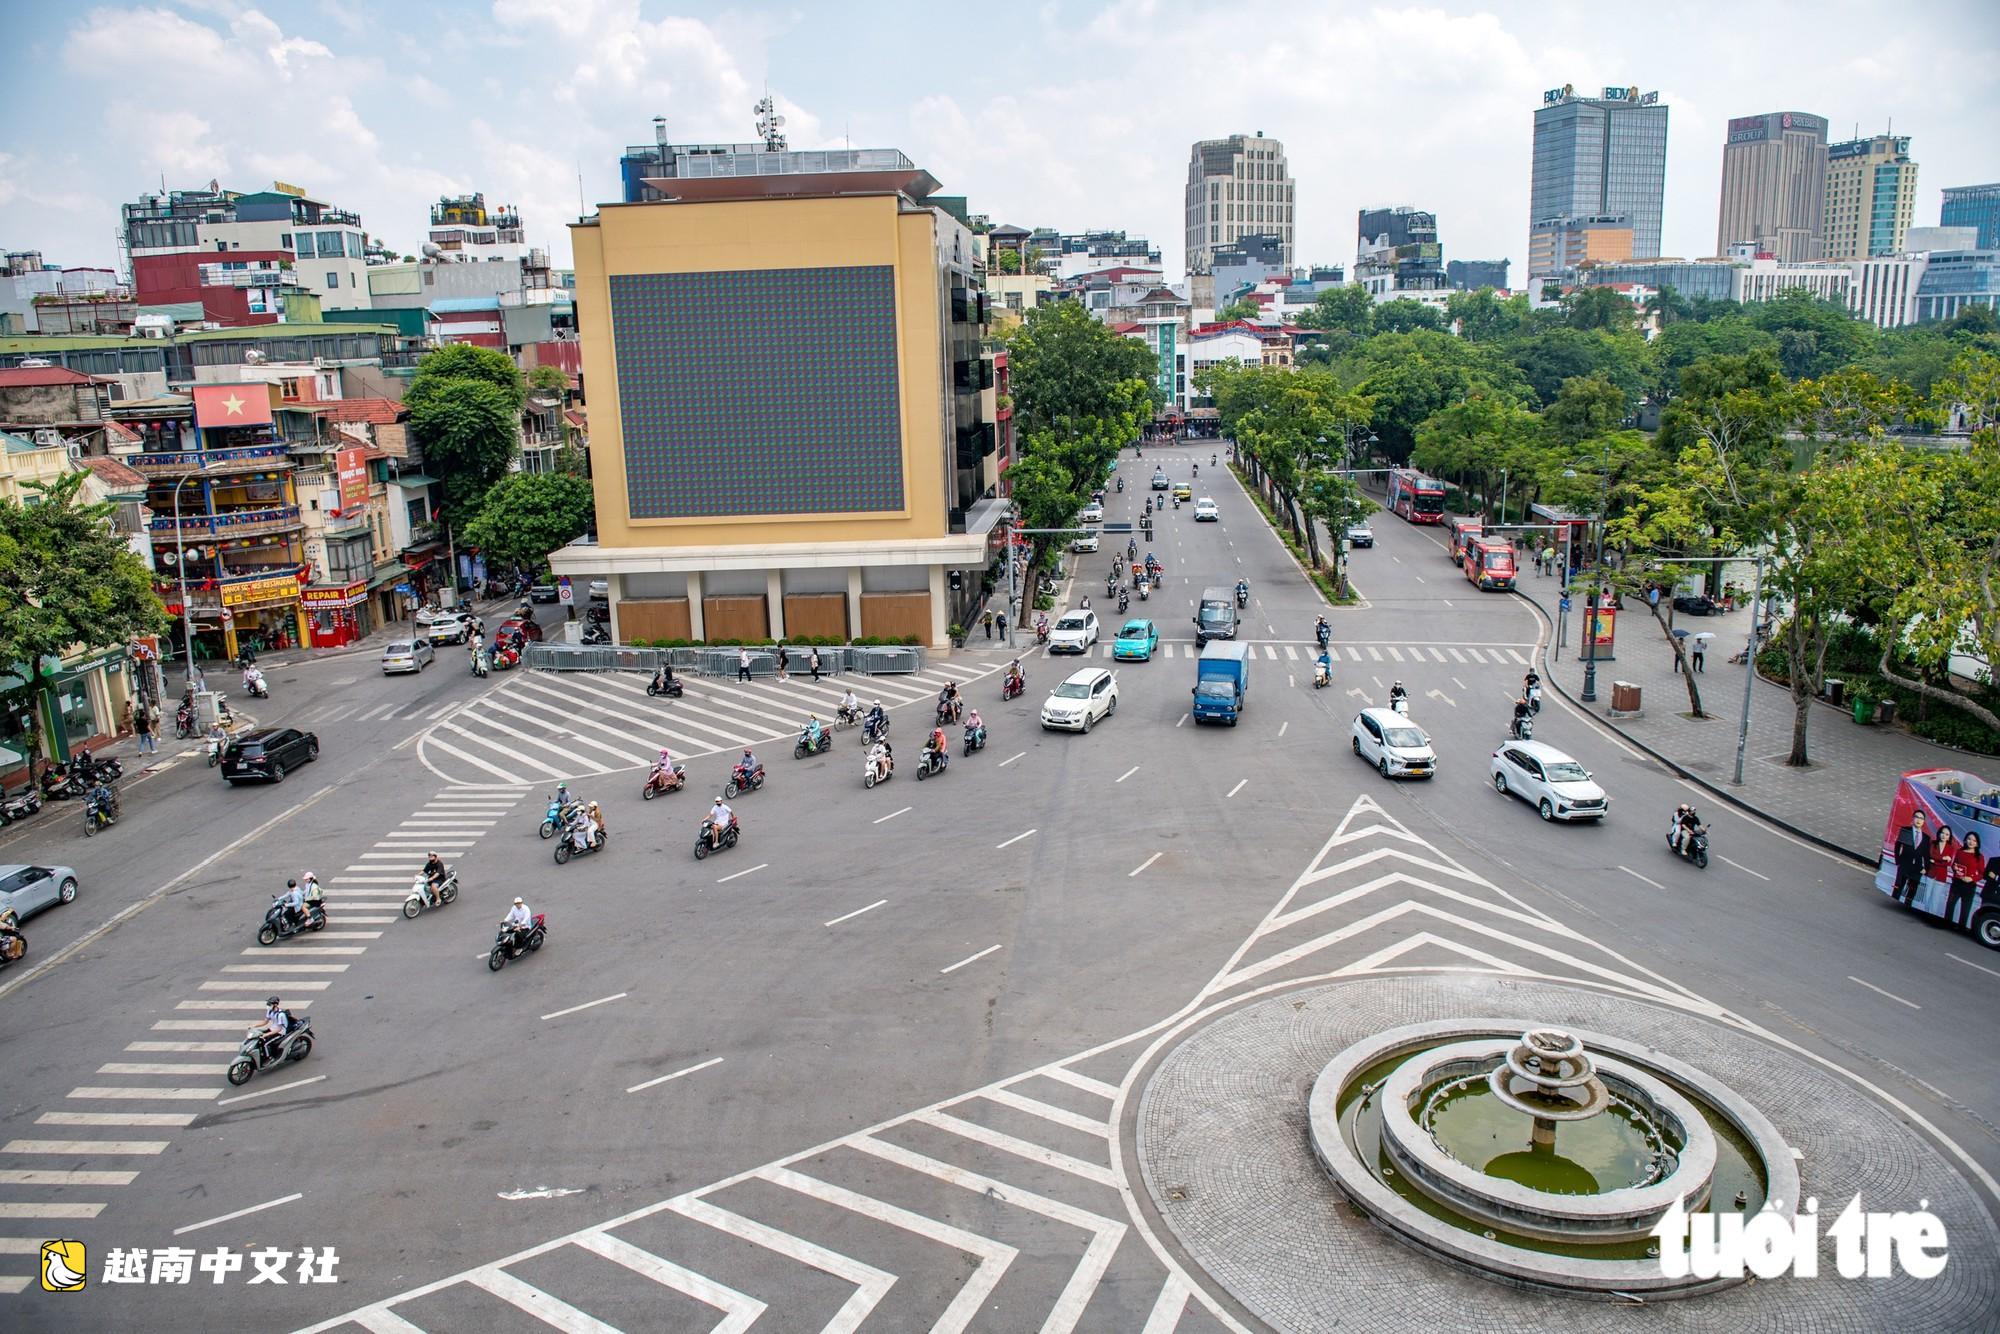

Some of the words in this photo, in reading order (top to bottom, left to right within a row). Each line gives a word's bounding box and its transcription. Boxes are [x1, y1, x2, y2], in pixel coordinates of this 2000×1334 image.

[1544, 87, 1565, 102] BIDV
[1605, 87, 1630, 100] BIDV
[1730, 131, 1765, 142] GROUP
[306, 591, 339, 600] REPAIR
[133, 640, 155, 659] SPA
[75, 657, 106, 673] Vietcombank
[109, 664, 120, 672] ATM
